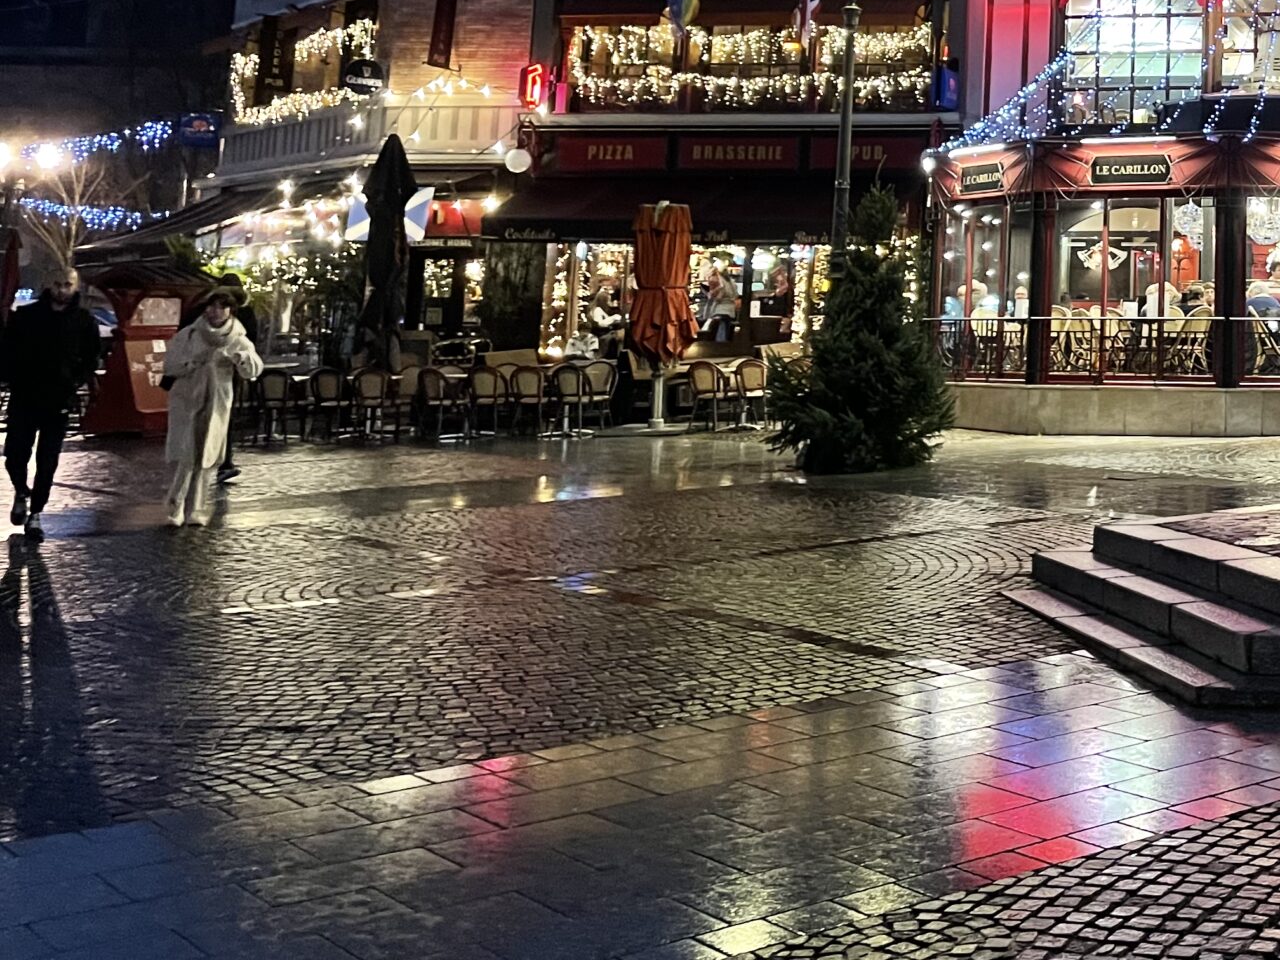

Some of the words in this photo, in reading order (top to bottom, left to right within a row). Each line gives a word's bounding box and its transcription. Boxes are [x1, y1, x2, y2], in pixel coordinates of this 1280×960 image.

[587, 144, 635, 161] PIZZA
[692, 144, 784, 161] BRASSERIE
[1096, 165, 1110, 176] LE
[1111, 163, 1167, 175] CARILLON
[971, 172, 1001, 184] CARILLON
[505, 227, 556, 240] Cocktails
